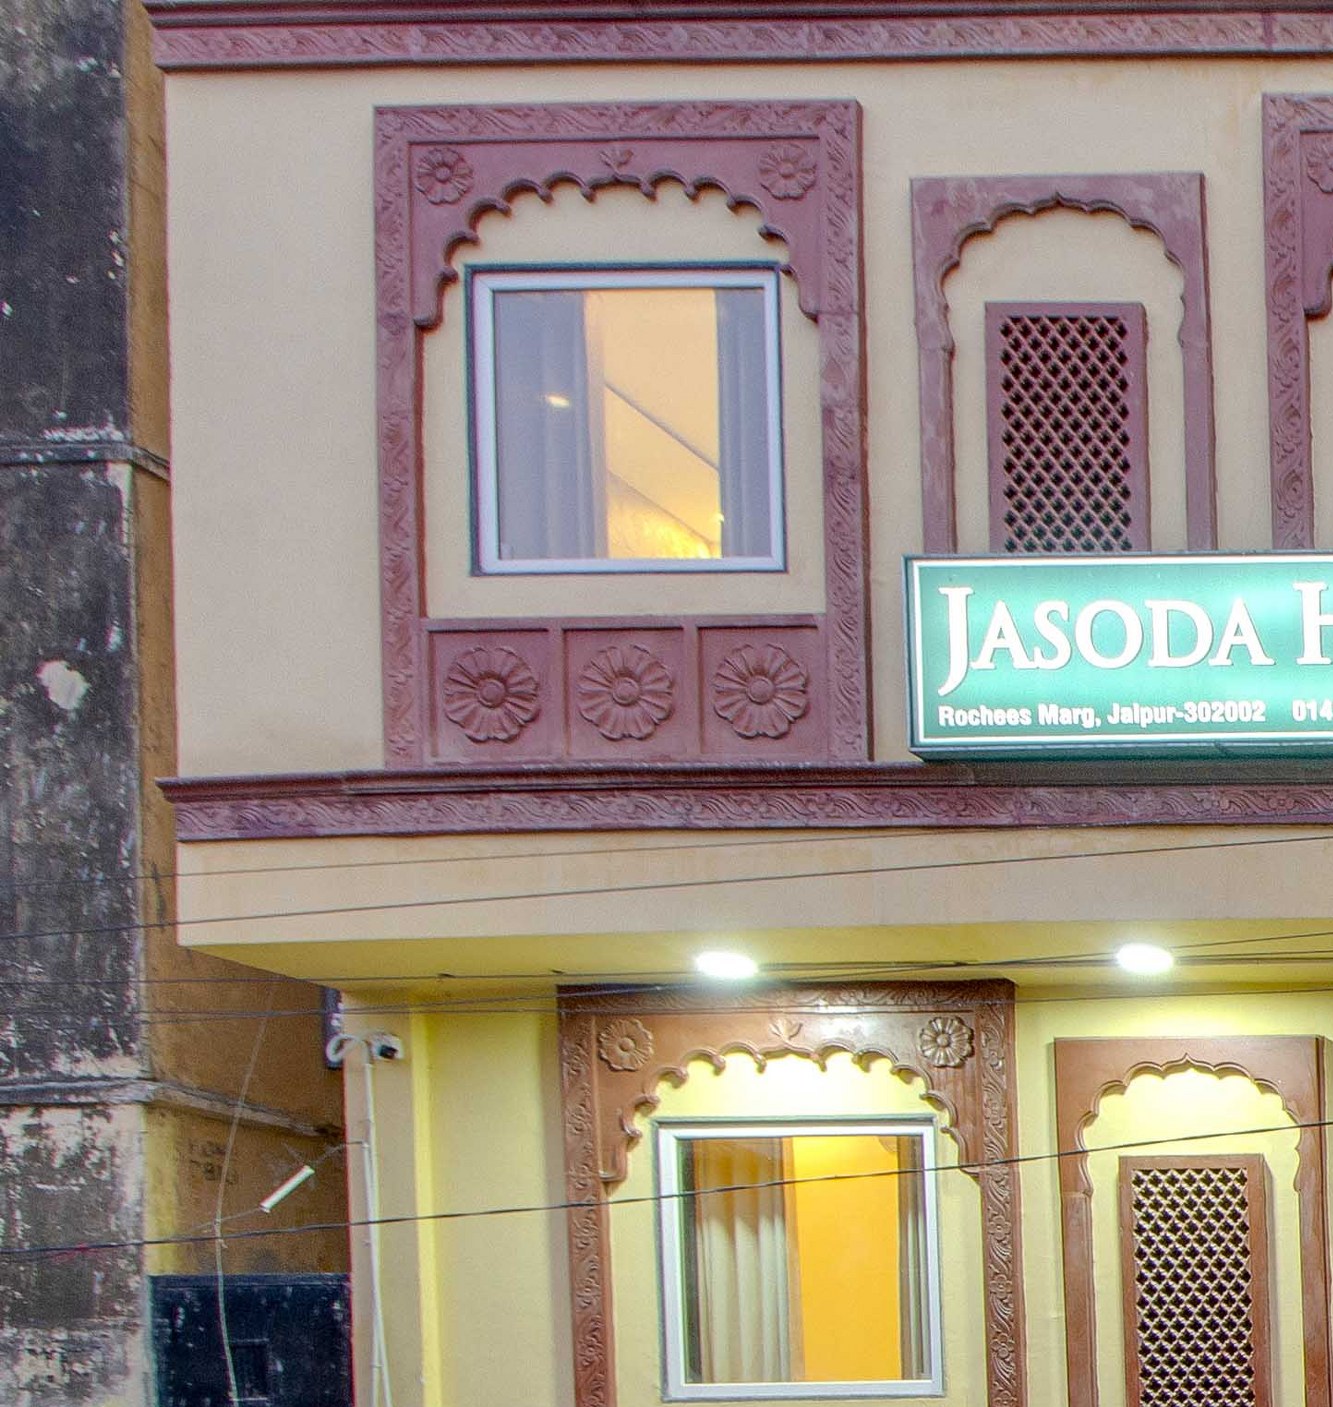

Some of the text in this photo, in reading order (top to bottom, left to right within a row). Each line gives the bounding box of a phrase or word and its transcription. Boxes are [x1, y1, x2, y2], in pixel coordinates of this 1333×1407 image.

[937, 586, 1276, 696] JASODA
[938, 705, 1031, 726] Rochees
[1037, 704, 1101, 729] Marg,
[1107, 700, 1266, 727] Jaipur-302002
